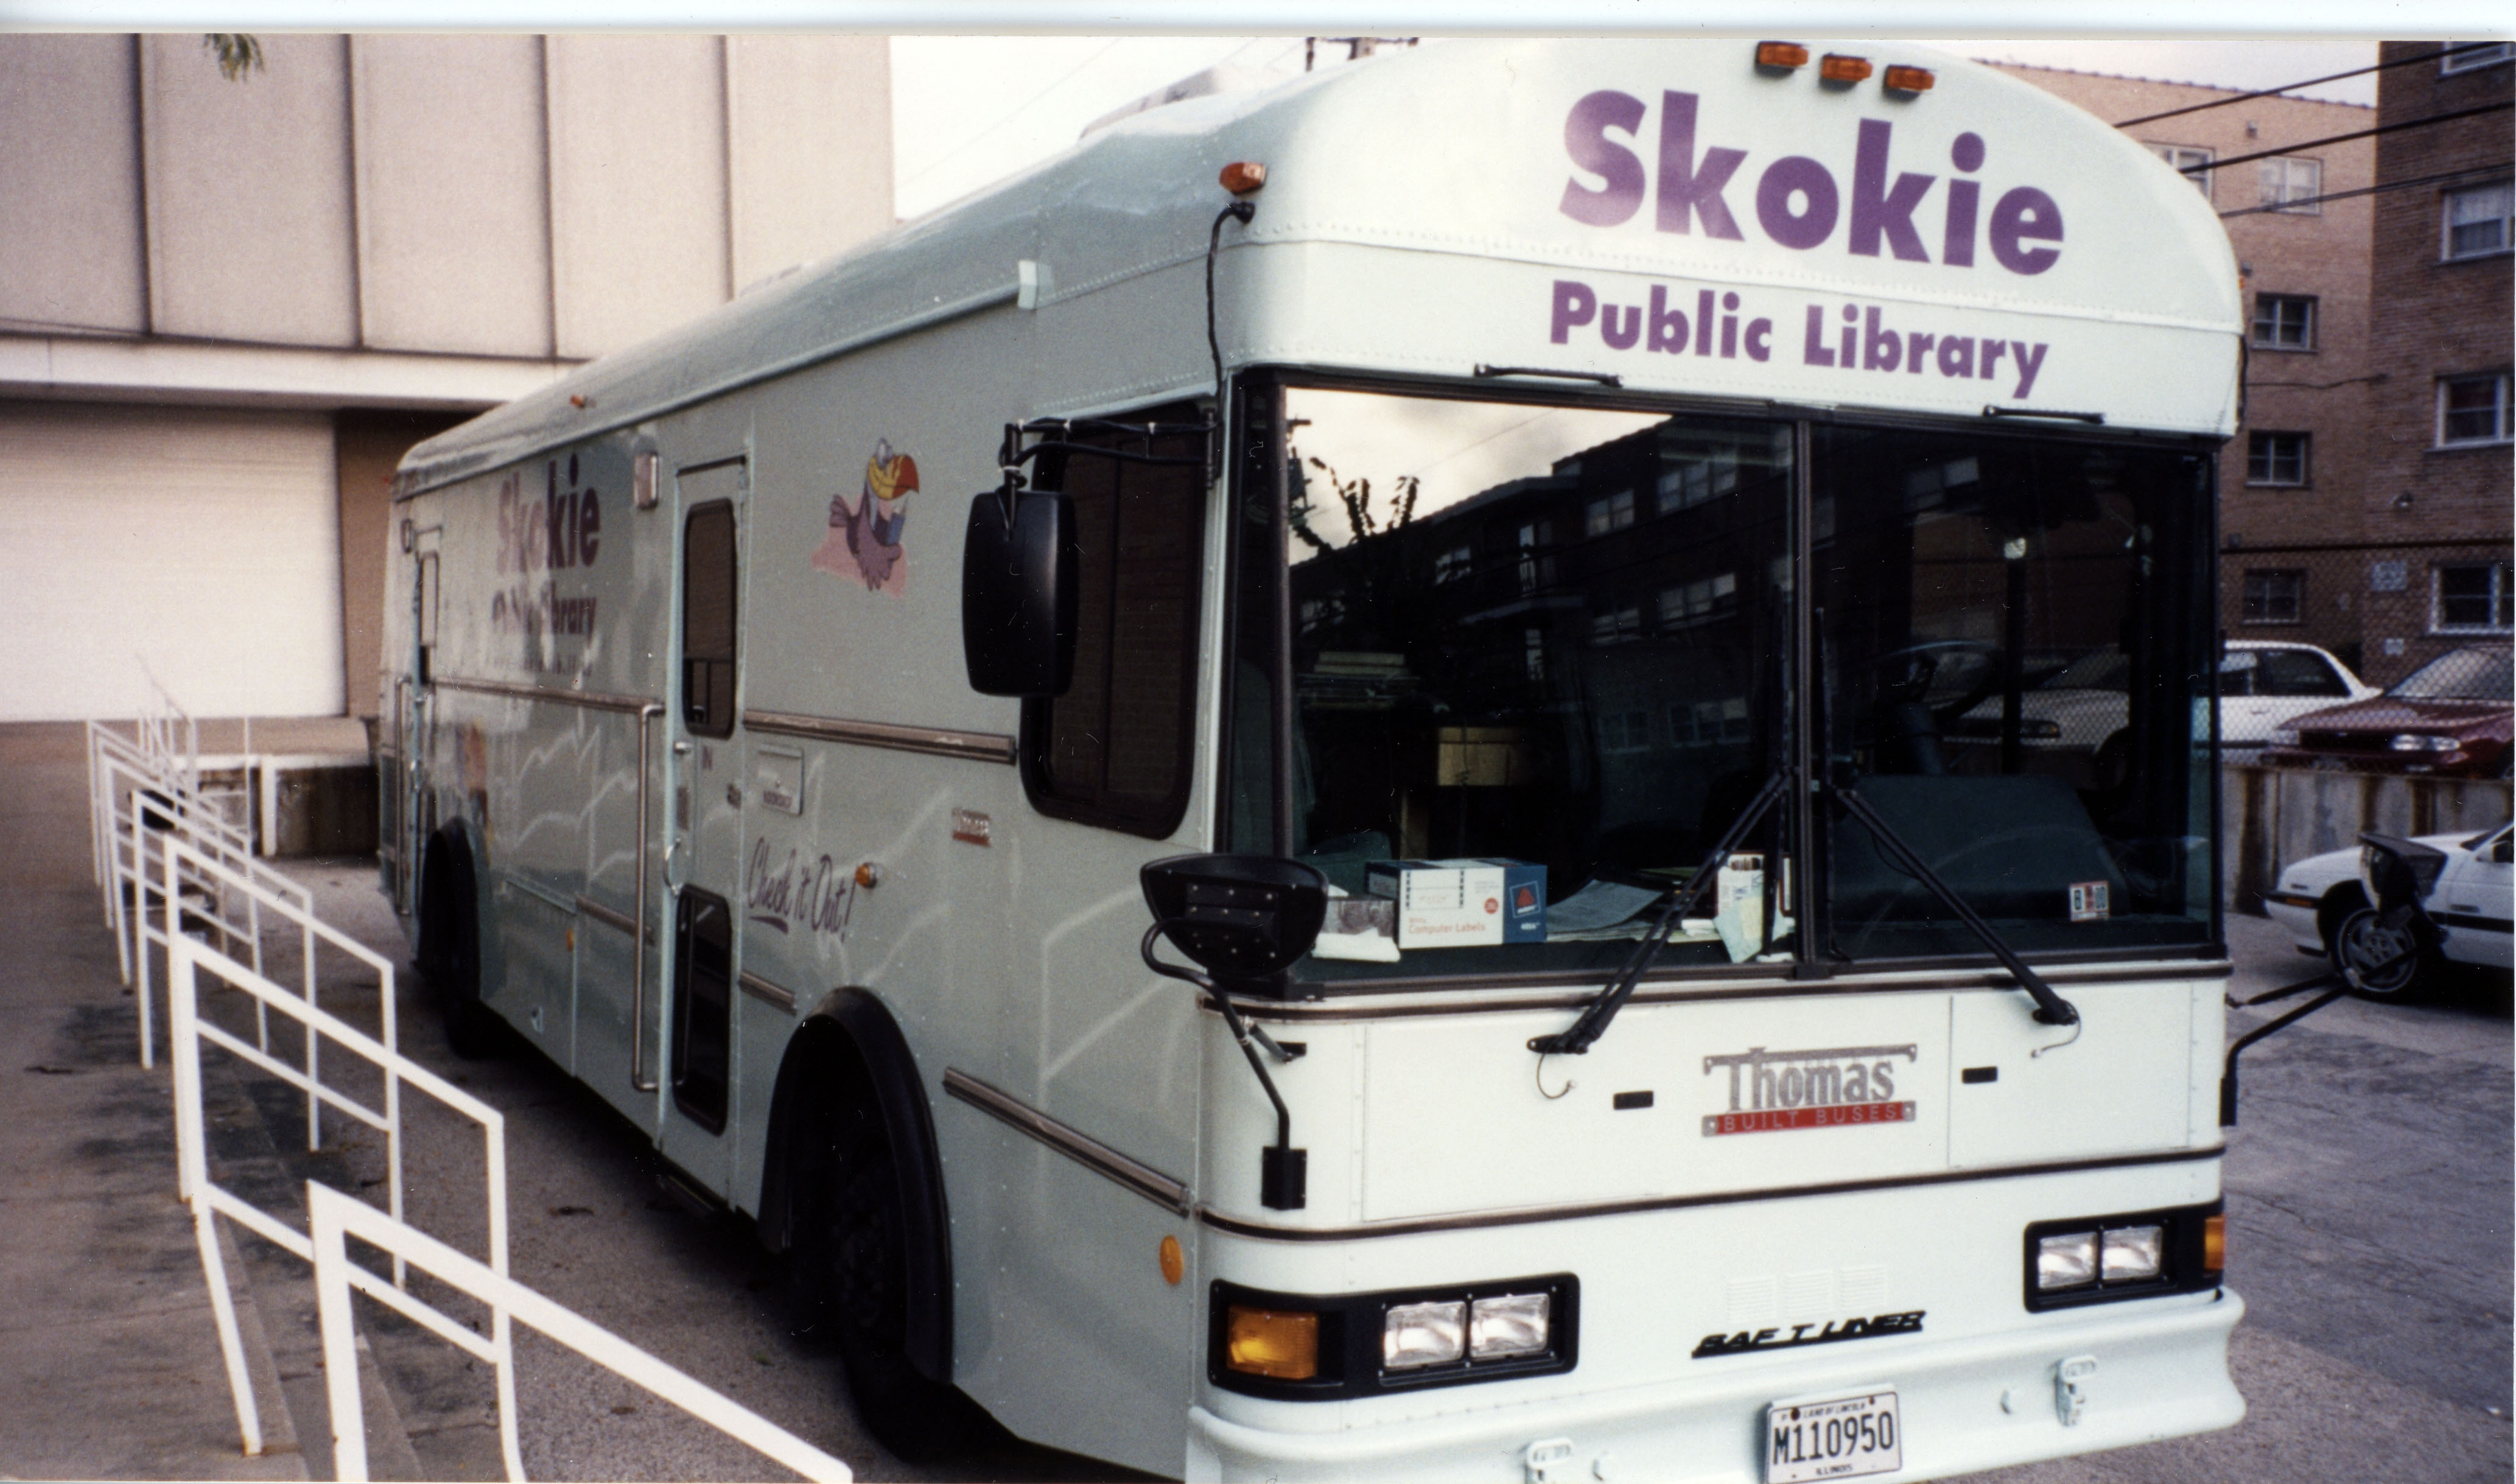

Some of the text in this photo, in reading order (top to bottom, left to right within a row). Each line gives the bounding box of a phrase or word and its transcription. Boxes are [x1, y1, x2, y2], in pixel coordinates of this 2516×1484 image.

[1559, 89, 2064, 276] Skokie
[1551, 280, 2050, 399] Public Library
[748, 837, 796, 918] Check
[811, 853, 858, 943] Out!
[1408, 922, 1485, 935] Computer Labels
[1703, 1044, 1918, 1113] Thomas
[1723, 1105, 1897, 1132] BUILT BUSES
[1773, 1410, 1894, 1465] M110950
[1815, 1463, 1853, 1476] ILLINOIS
